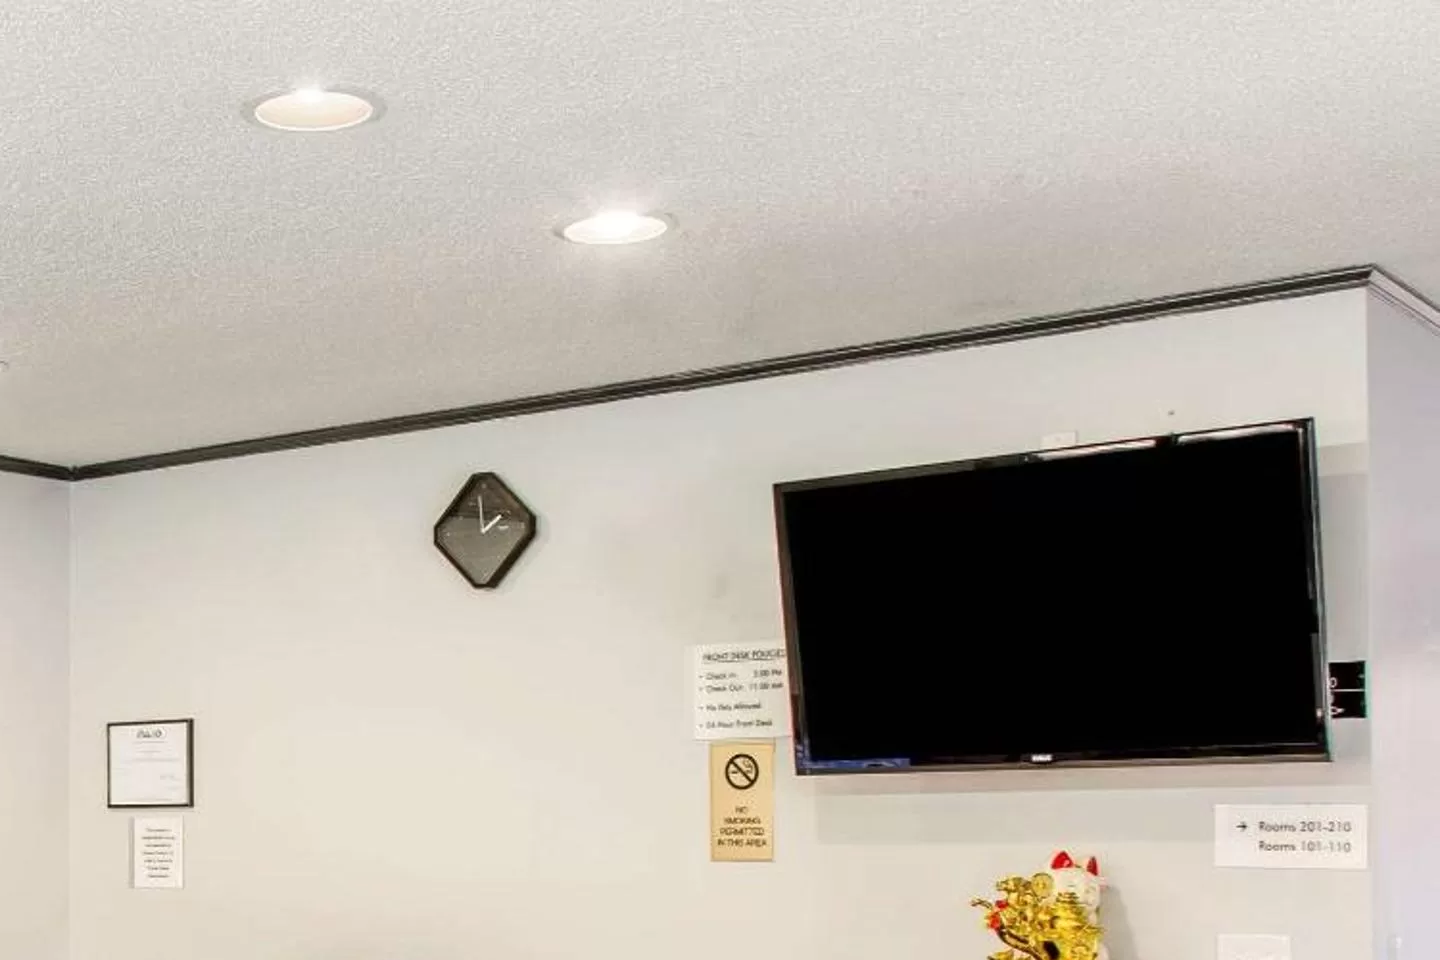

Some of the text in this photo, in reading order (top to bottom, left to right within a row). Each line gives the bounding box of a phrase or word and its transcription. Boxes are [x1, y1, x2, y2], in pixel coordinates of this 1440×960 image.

[735, 806, 749, 814] NO
[1258, 821, 1352, 832] Rooms 201-210
[1258, 840, 1351, 852] Rooms 101-110
